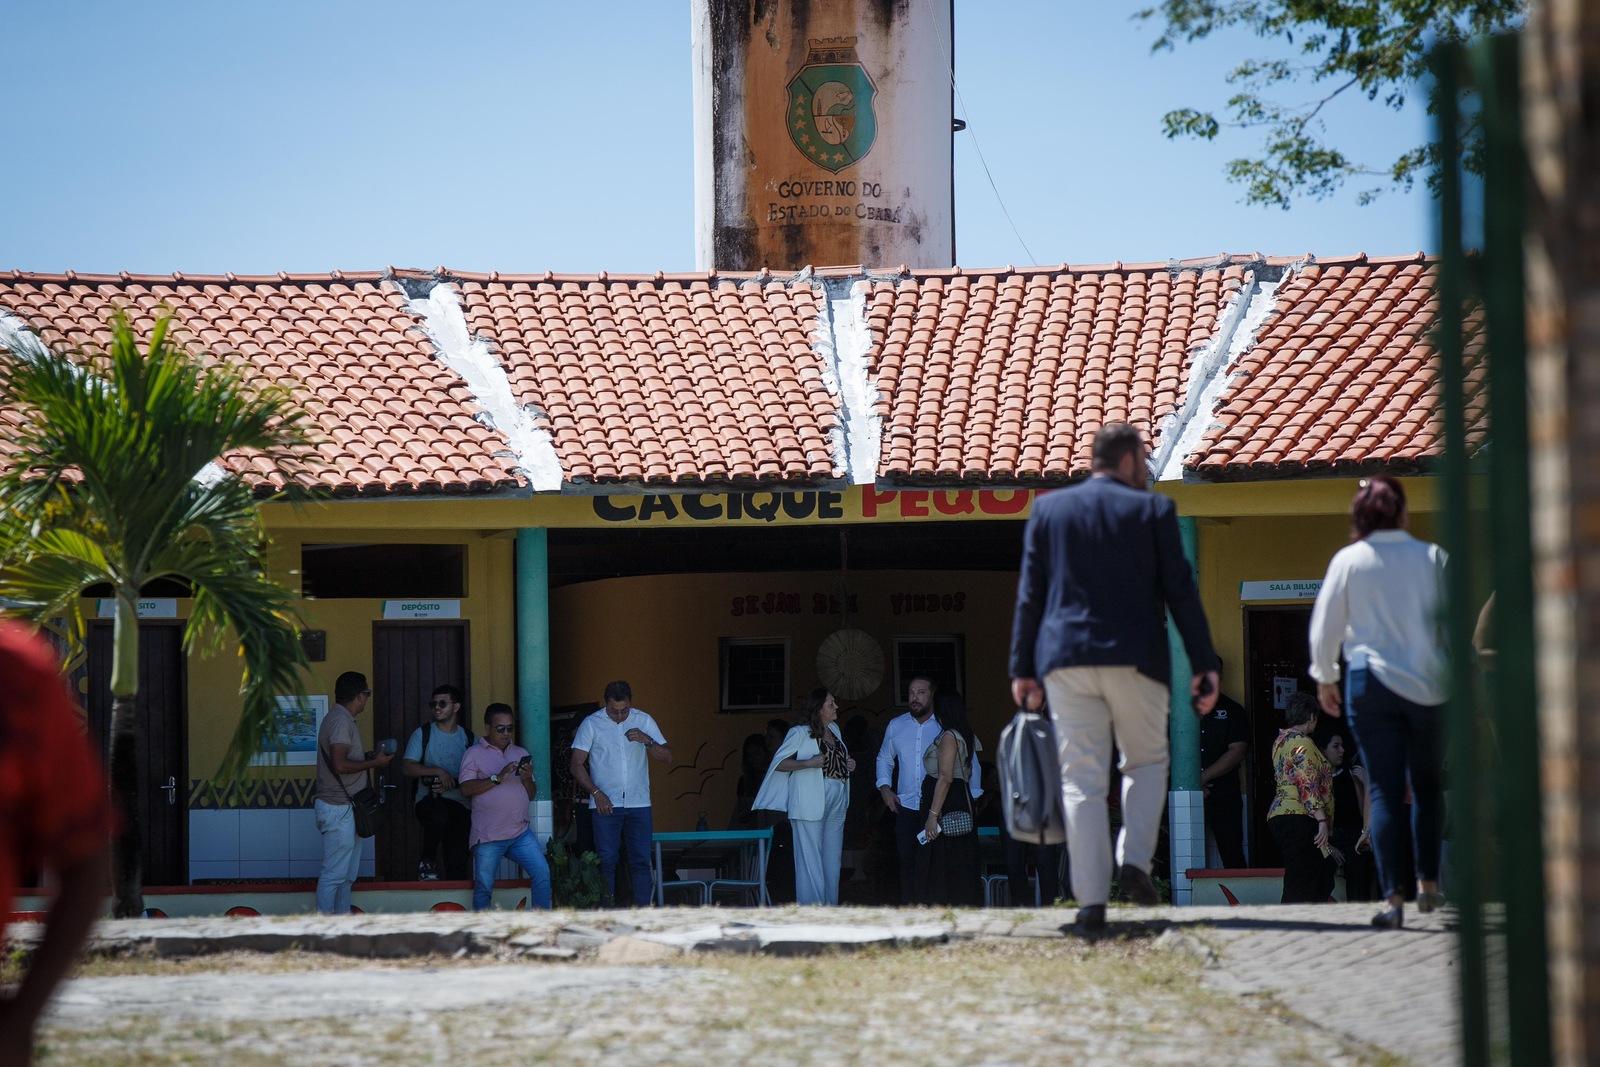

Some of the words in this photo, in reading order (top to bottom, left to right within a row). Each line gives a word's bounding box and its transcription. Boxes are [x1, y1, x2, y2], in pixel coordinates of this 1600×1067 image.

[779, 181, 856, 198] GOVERNO
[863, 182, 881, 198] DO
[835, 207, 851, 217] DO
[593, 490, 843, 522] CACIQUE
[862, 484, 1058, 518] PEQU
[1269, 584, 1292, 592] SALA
[1293, 583, 1323, 592] BILUQU
[401, 602, 440, 611] DEPÓSITO
[731, 592, 800, 616] SEJAM
[889, 592, 967, 615] VINDOS
